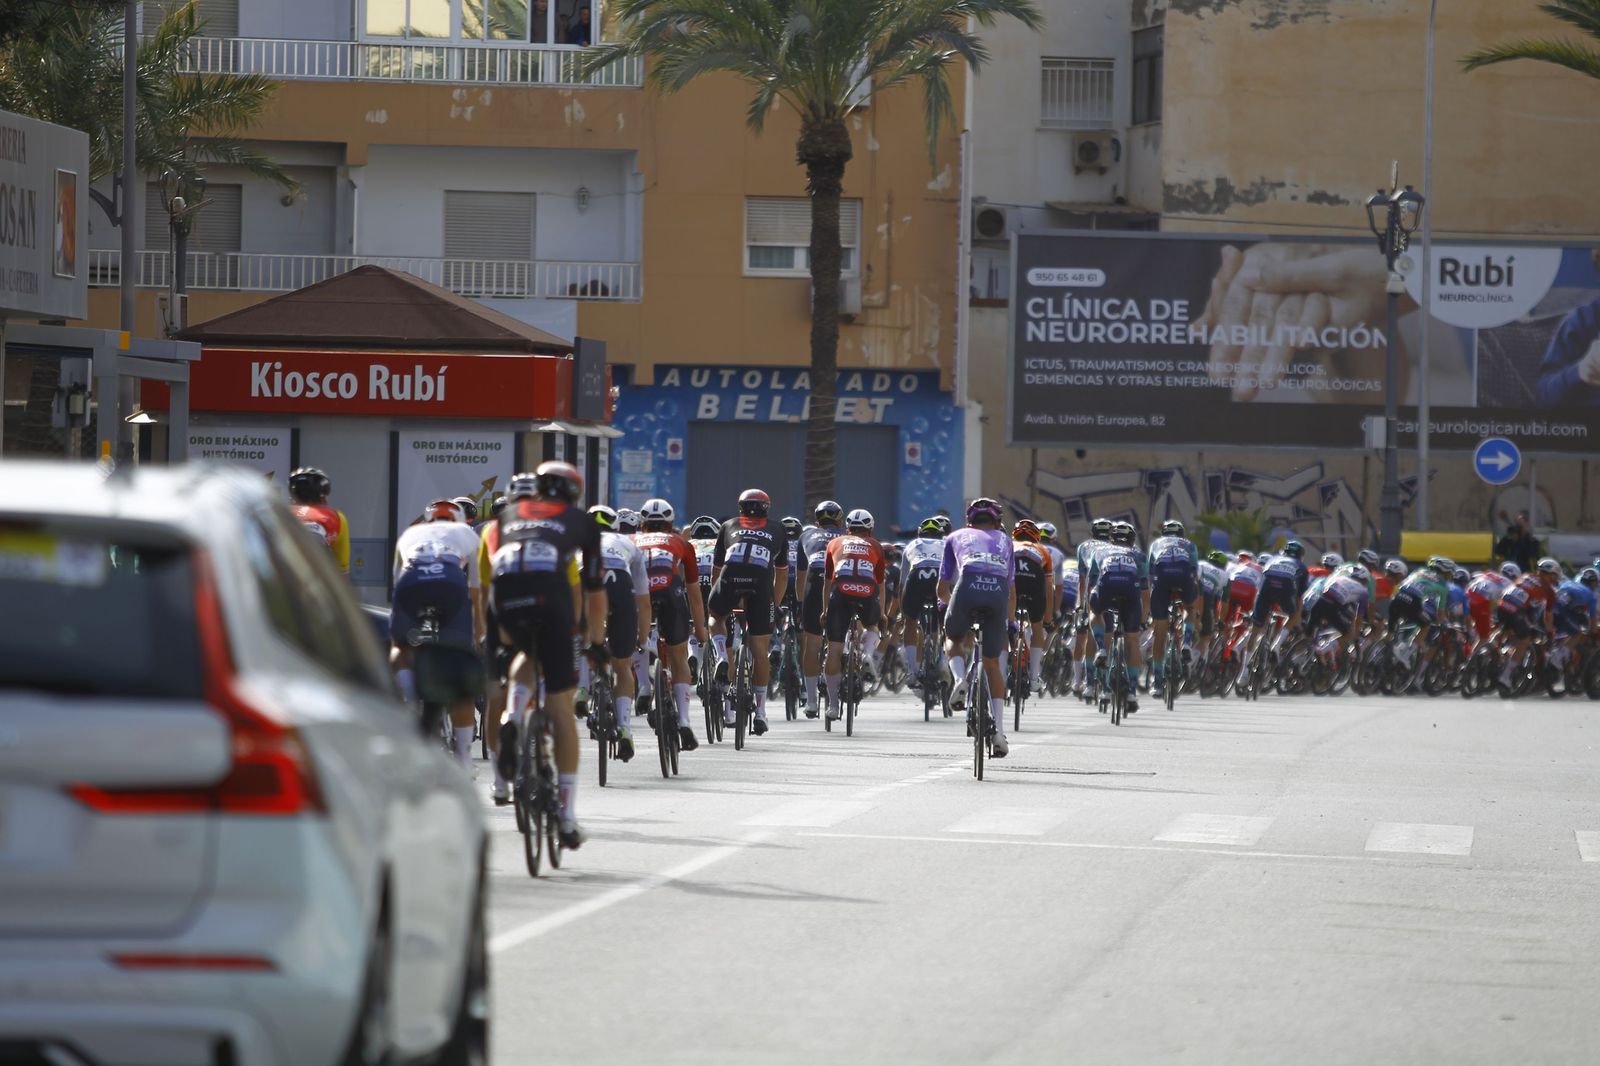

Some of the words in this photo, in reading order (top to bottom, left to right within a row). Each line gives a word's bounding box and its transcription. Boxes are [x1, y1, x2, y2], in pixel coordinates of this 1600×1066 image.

[1439, 255, 1516, 287] Rubí
[1439, 292, 1514, 303] NEUROCLÍNICA
[1026, 293, 1142, 321] CLÍNICA
[1150, 299, 1189, 321] DE
[1026, 321, 1388, 349] NEURORREHABILITACIÓN
[1025, 359, 1067, 371] ICTUS,
[1070, 359, 1175, 371] TRAUMATISMOS
[250, 361, 358, 399] Kiosco
[368, 364, 448, 402] Rubí
[1025, 374, 1104, 385] DEMENCIAS
[1106, 375, 1115, 385] Y
[1118, 375, 1162, 386] OTRAS
[1165, 376, 1274, 389] ENFERMEDADES
[1024, 414, 1056, 424] Avda.
[1059, 414, 1094, 425] Unión
[1097, 414, 1149, 427] Europea,
[189, 437, 211, 446] ORO
[214, 437, 230, 446] EN
[232, 435, 279, 447] MÁXIMO
[412, 441, 435, 450] ORO
[438, 441, 454, 450] EN
[456, 438, 502, 451] MÁXIMO
[202, 447, 265, 461] HISTÓRICO
[426, 452, 488, 464] HISTÓRICO
[731, 529, 773, 541] TUDOR
[969, 582, 1002, 592] ALULA
